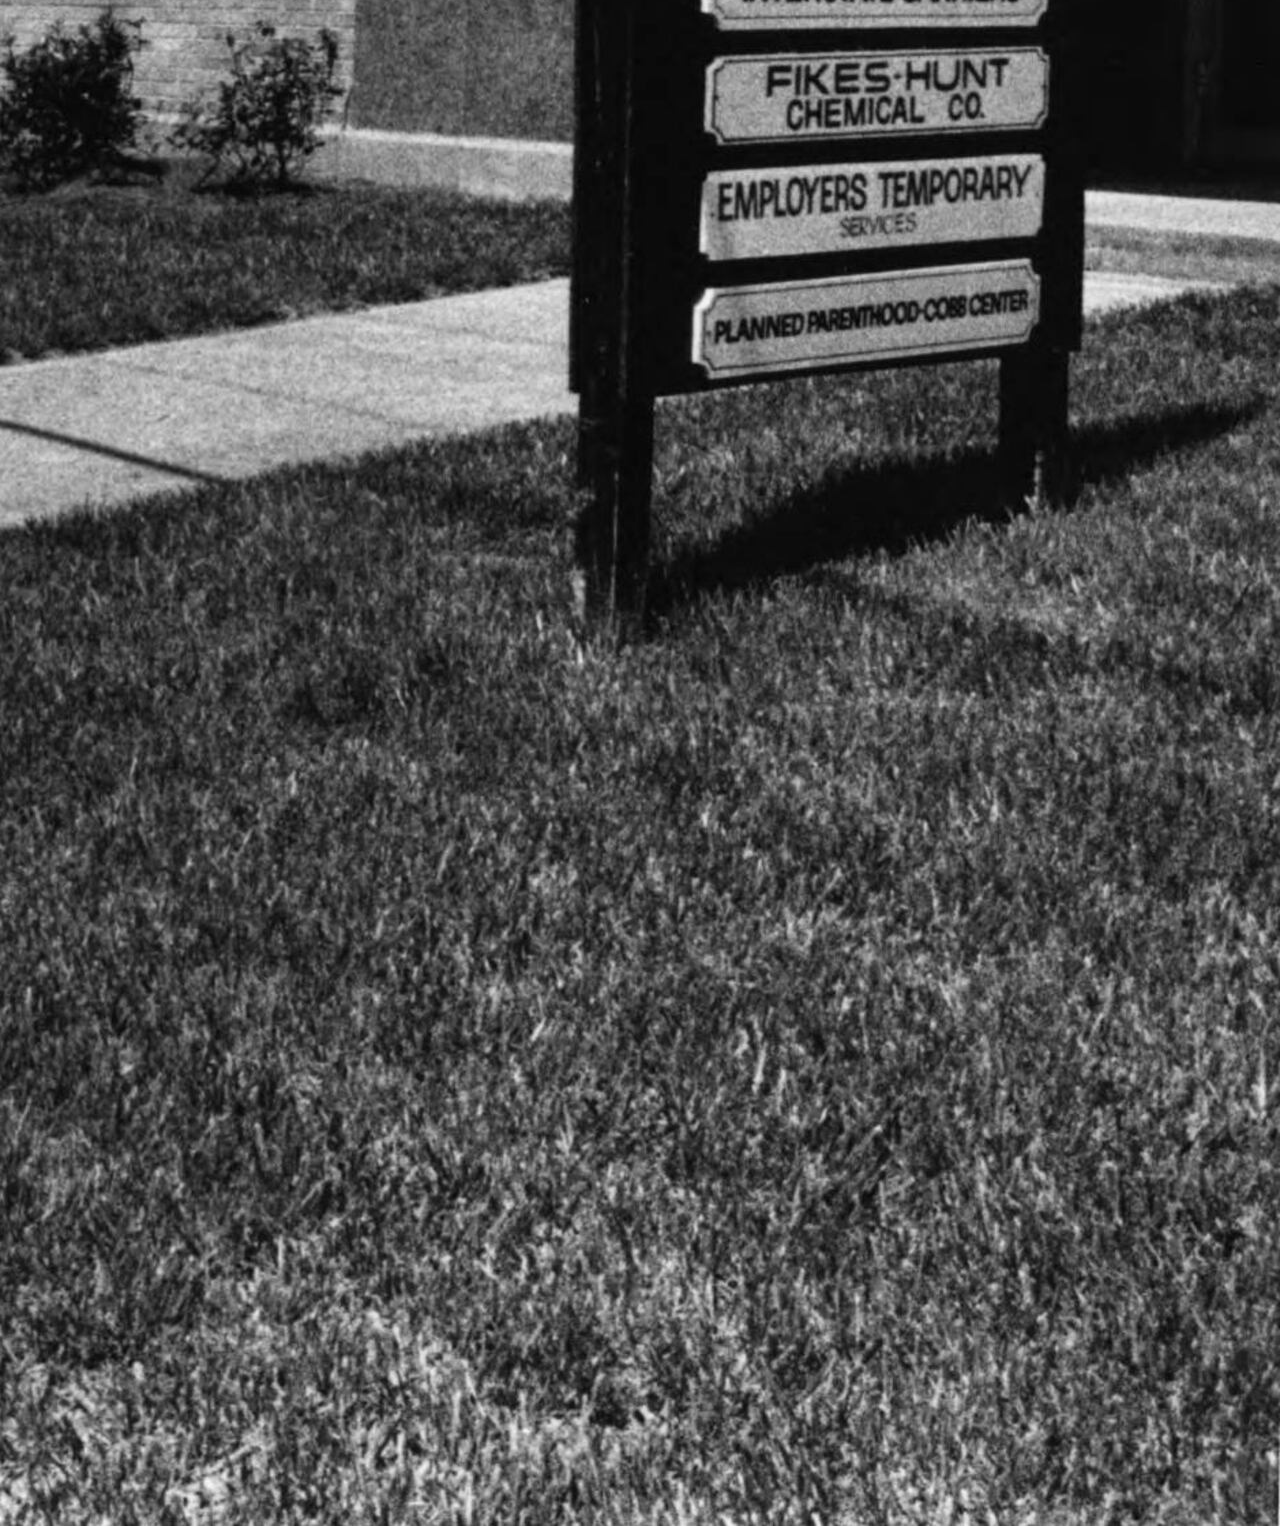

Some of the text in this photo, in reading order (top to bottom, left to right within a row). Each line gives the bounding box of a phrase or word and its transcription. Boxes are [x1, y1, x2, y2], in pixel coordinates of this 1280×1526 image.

[766, 58, 1009, 98] FIKES-HUNT
[787, 92, 985, 130] CHEMICAL CO.
[718, 165, 1032, 222] EMPLOYERS TEMPORARY
[840, 212, 917, 238] SERVICES
[715, 313, 804, 343] PLANNED
[969, 289, 1028, 317] CENTER
